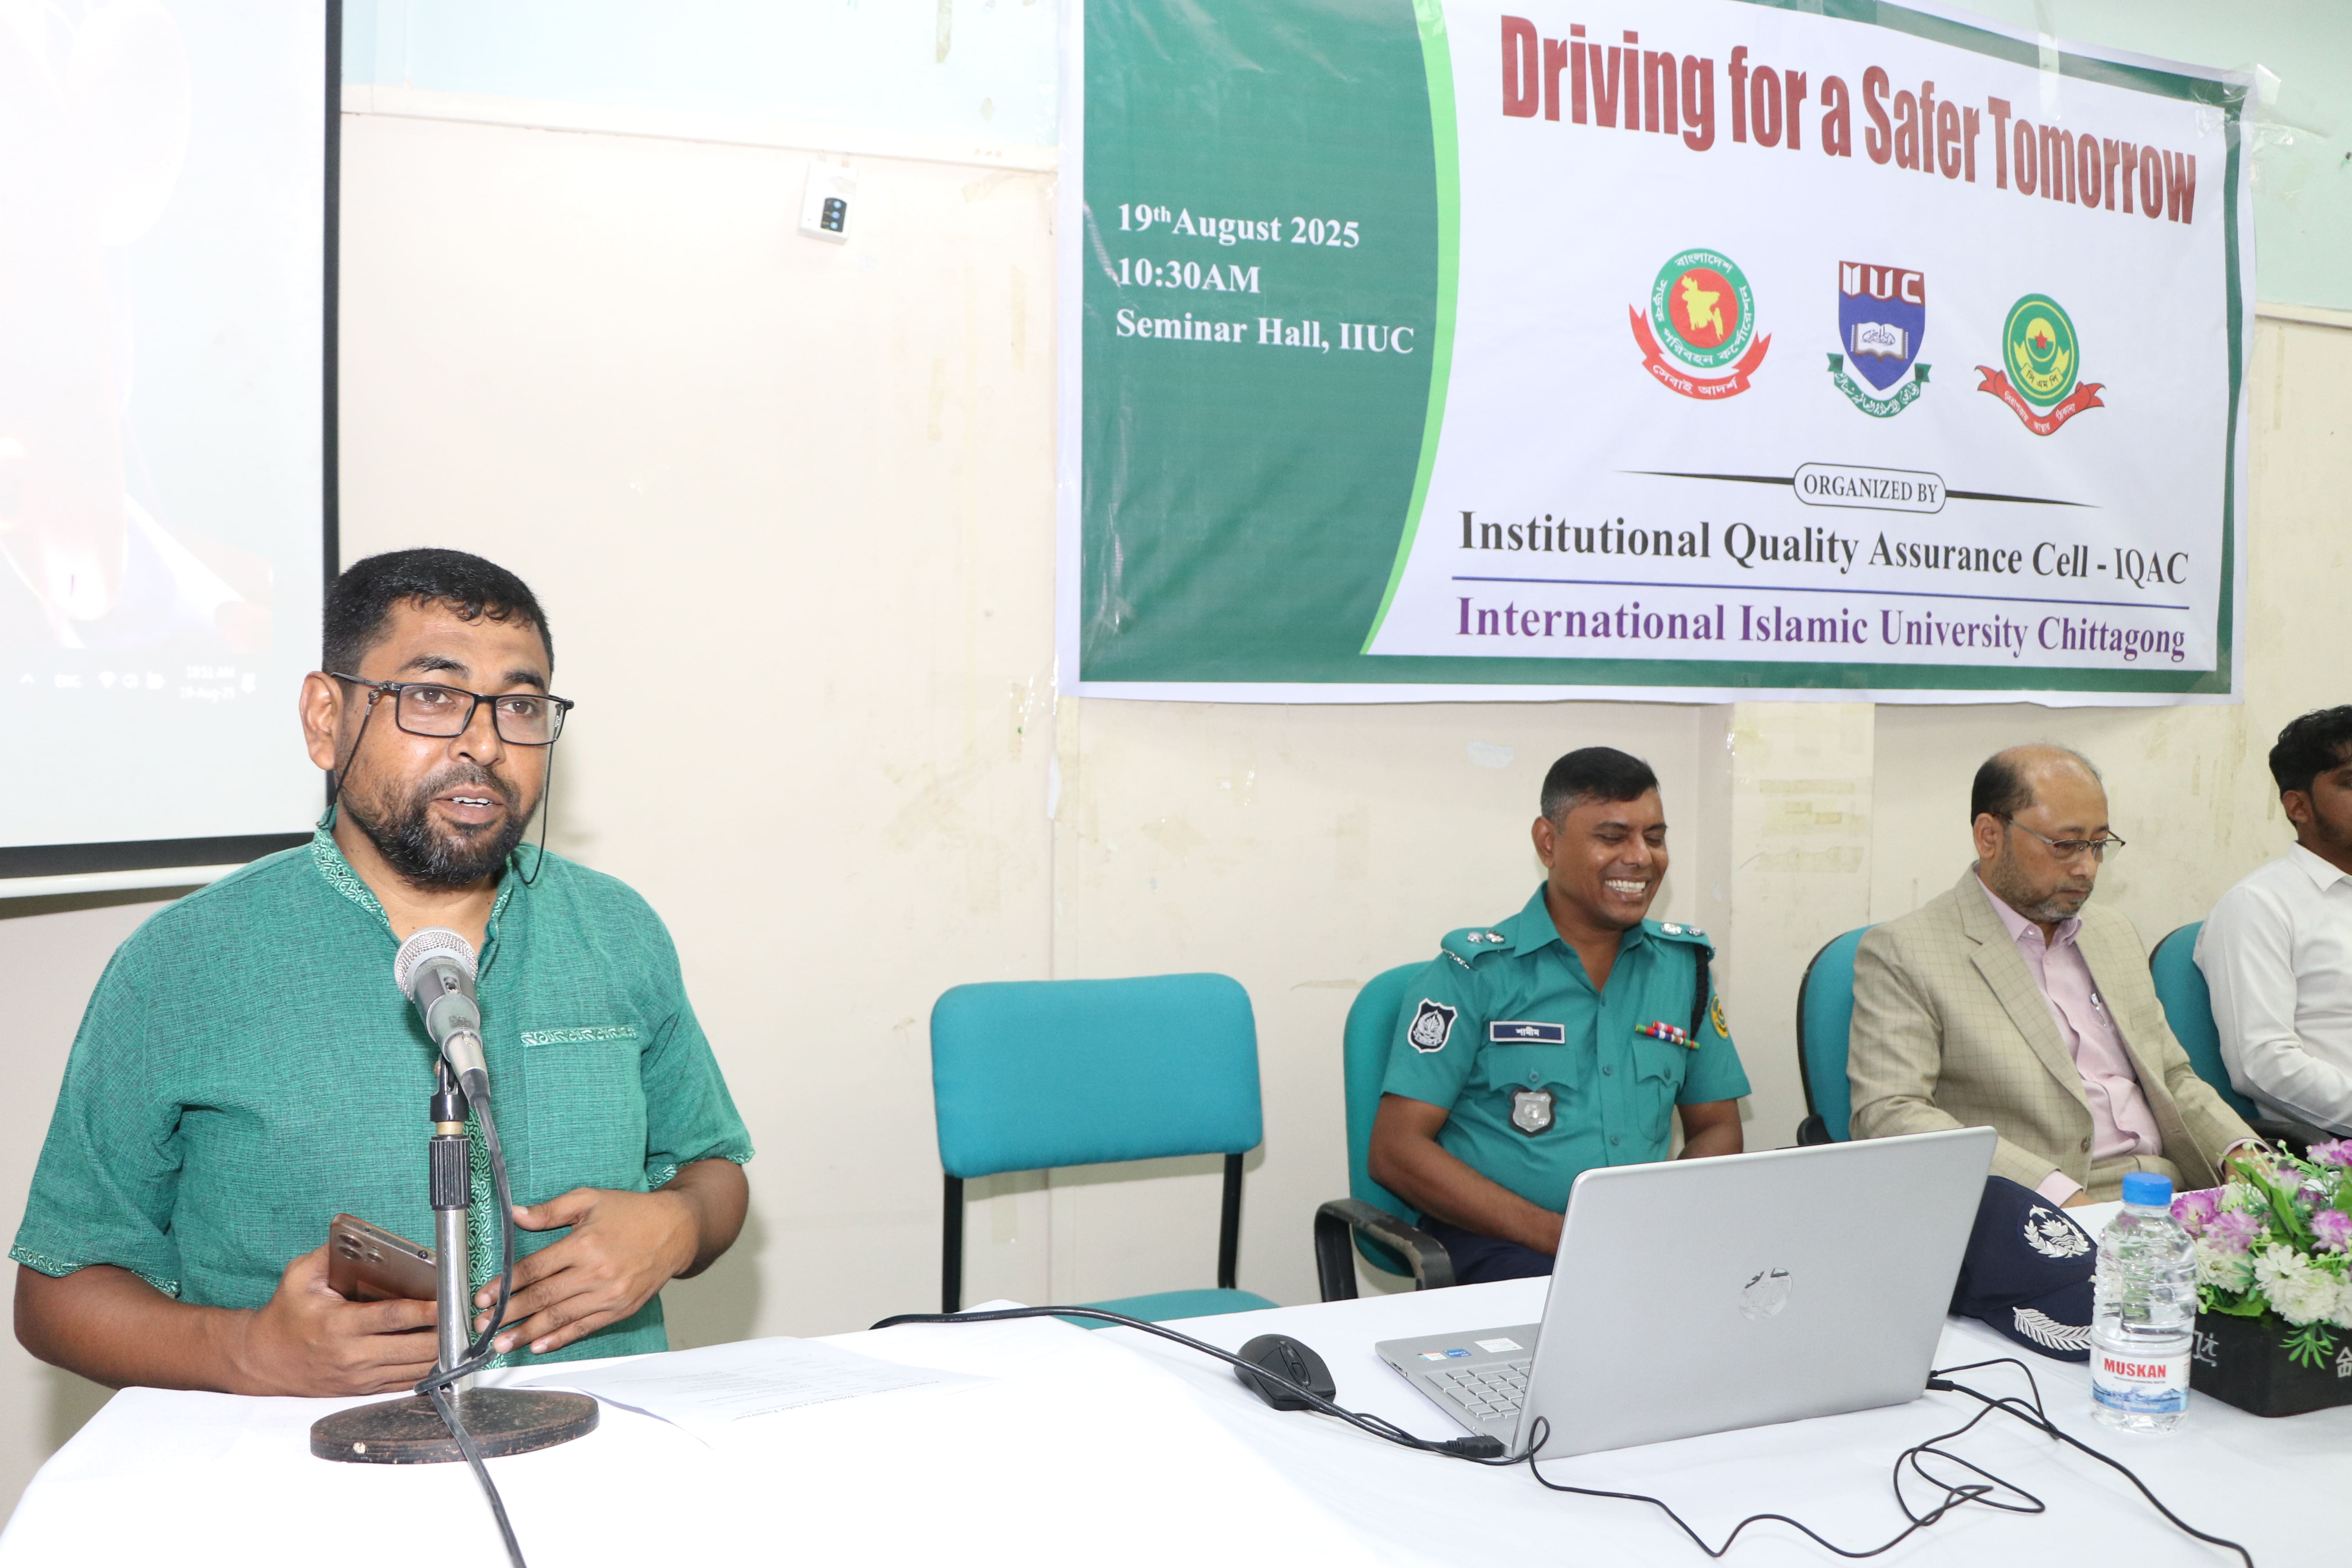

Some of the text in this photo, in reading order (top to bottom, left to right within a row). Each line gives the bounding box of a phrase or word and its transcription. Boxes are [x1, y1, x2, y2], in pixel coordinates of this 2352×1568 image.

[1502, 16, 2195, 224] Driving for a Safer Tomorrow
[1292, 217, 1359, 247] 2025
[1120, 258, 1258, 292] 10:30AM
[1675, 252, 1733, 273] বাংলাদেশ
[1117, 309, 1413, 353] Seminar Hall, IIUC
[1664, 328, 1713, 365] পরিবহন
[1698, 377, 1738, 396] আদর্শ
[1804, 475, 1934, 502] ORGANIZED BY
[1463, 512, 1709, 557] Institutional
[1725, 523, 1858, 574] Quality
[1869, 532, 2022, 573] Assurance
[2033, 543, 2087, 577] Cell
[2116, 549, 2188, 588] IQAC
[1459, 598, 2184, 662] International Islamic University Chittagong
[2104, 1357, 2167, 1378] MUSKAN
